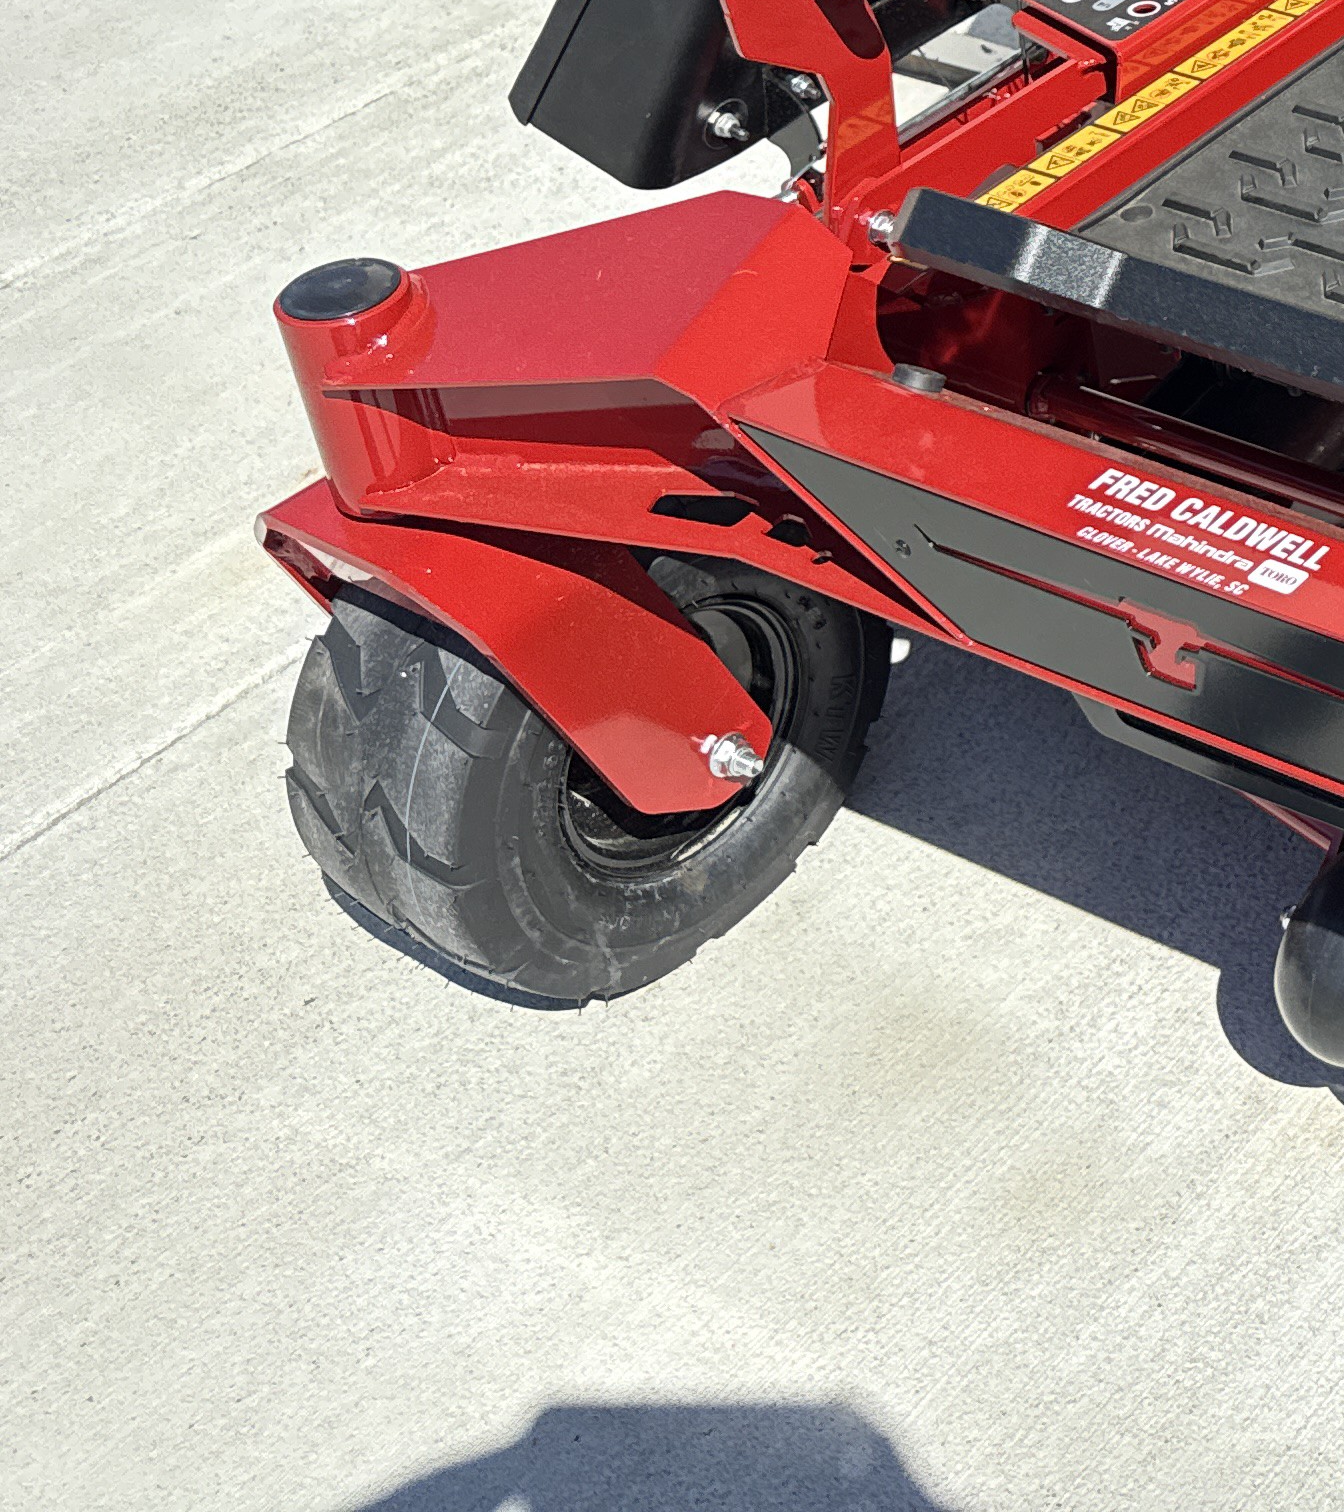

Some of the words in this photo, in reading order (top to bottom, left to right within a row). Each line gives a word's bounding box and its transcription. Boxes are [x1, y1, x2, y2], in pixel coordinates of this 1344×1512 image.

[1067, 493, 1151, 533] TRACTORS
[1261, 564, 1298, 587] TORO
[1076, 525, 1135, 554] CLOVER
[1136, 547, 1177, 571] LAKE
[1223, 579, 1250, 596] SC
[1087, 467, 1176, 512] FRED
[1170, 497, 1331, 571] CALDWELL
